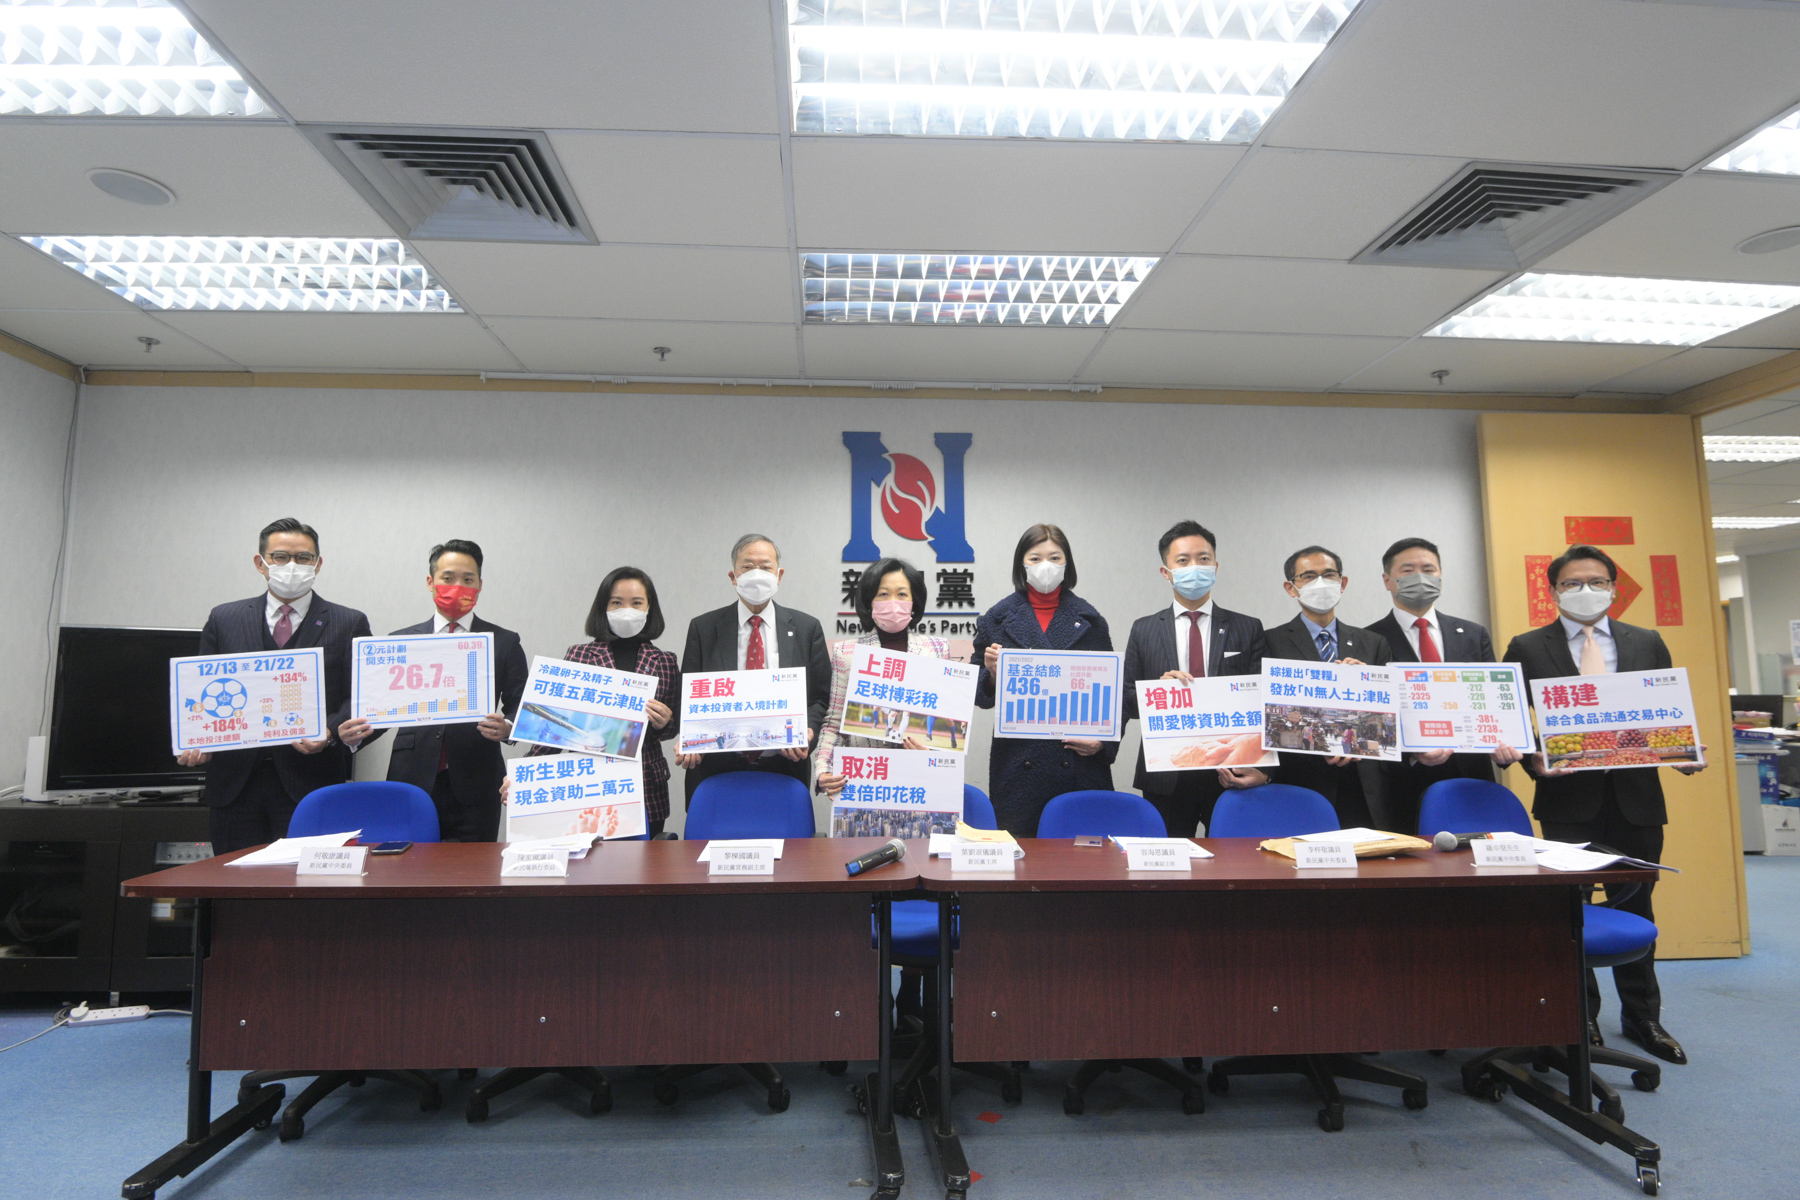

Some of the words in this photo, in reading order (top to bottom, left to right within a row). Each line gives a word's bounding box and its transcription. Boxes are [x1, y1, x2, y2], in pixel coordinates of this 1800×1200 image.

[1534, 565, 1547, 612] 和氣生財
[940, 619, 980, 636] Party
[197, 661, 237, 676] 12/13
[241, 662, 251, 671] 至
[254, 657, 294, 672] 21/22
[366, 655, 407, 665] 開支升幅
[858, 653, 907, 682] 上調
[272, 672, 307, 683] +134%
[538, 664, 613, 685] 冷藏卵子及精子
[1007, 663, 1062, 678] 基金結餘
[689, 677, 736, 699] 重啟
[1006, 677, 1040, 695] 436
[1071, 678, 1085, 690] 66
[1410, 683, 1427, 691] -106
[1497, 684, 1510, 692] -63
[534, 679, 645, 712] 可獲五萬元津貼
[854, 680, 939, 709] 足球博彩稅
[1145, 686, 1193, 710] 增加
[1270, 682, 1391, 704] 發放「N無人士」津貼
[1408, 692, 1431, 700] -2325
[1467, 692, 1485, 700] -220
[1541, 683, 1599, 709] 構建
[688, 699, 788, 714] 資本投資者入境計劃
[1413, 701, 1428, 709] 293
[1469, 702, 1486, 710] -231
[1498, 702, 1515, 710] -291
[1148, 710, 1261, 731] 關愛隊資助金額
[1475, 714, 1494, 723] -381
[1545, 707, 1683, 727] 綜合食品流通交易中心
[202, 718, 248, 732] +184%
[263, 727, 306, 738] 純利及佣金
[1474, 725, 1498, 733] -2738
[187, 733, 240, 745] 本地投注總額
[1479, 735, 1497, 744] -479
[515, 758, 595, 783] 新生嬰兒
[841, 756, 889, 780] 取消
[514, 778, 635, 806] 現金資助二萬元
[961, 848, 1003, 856] 葉劉淑儀議員
